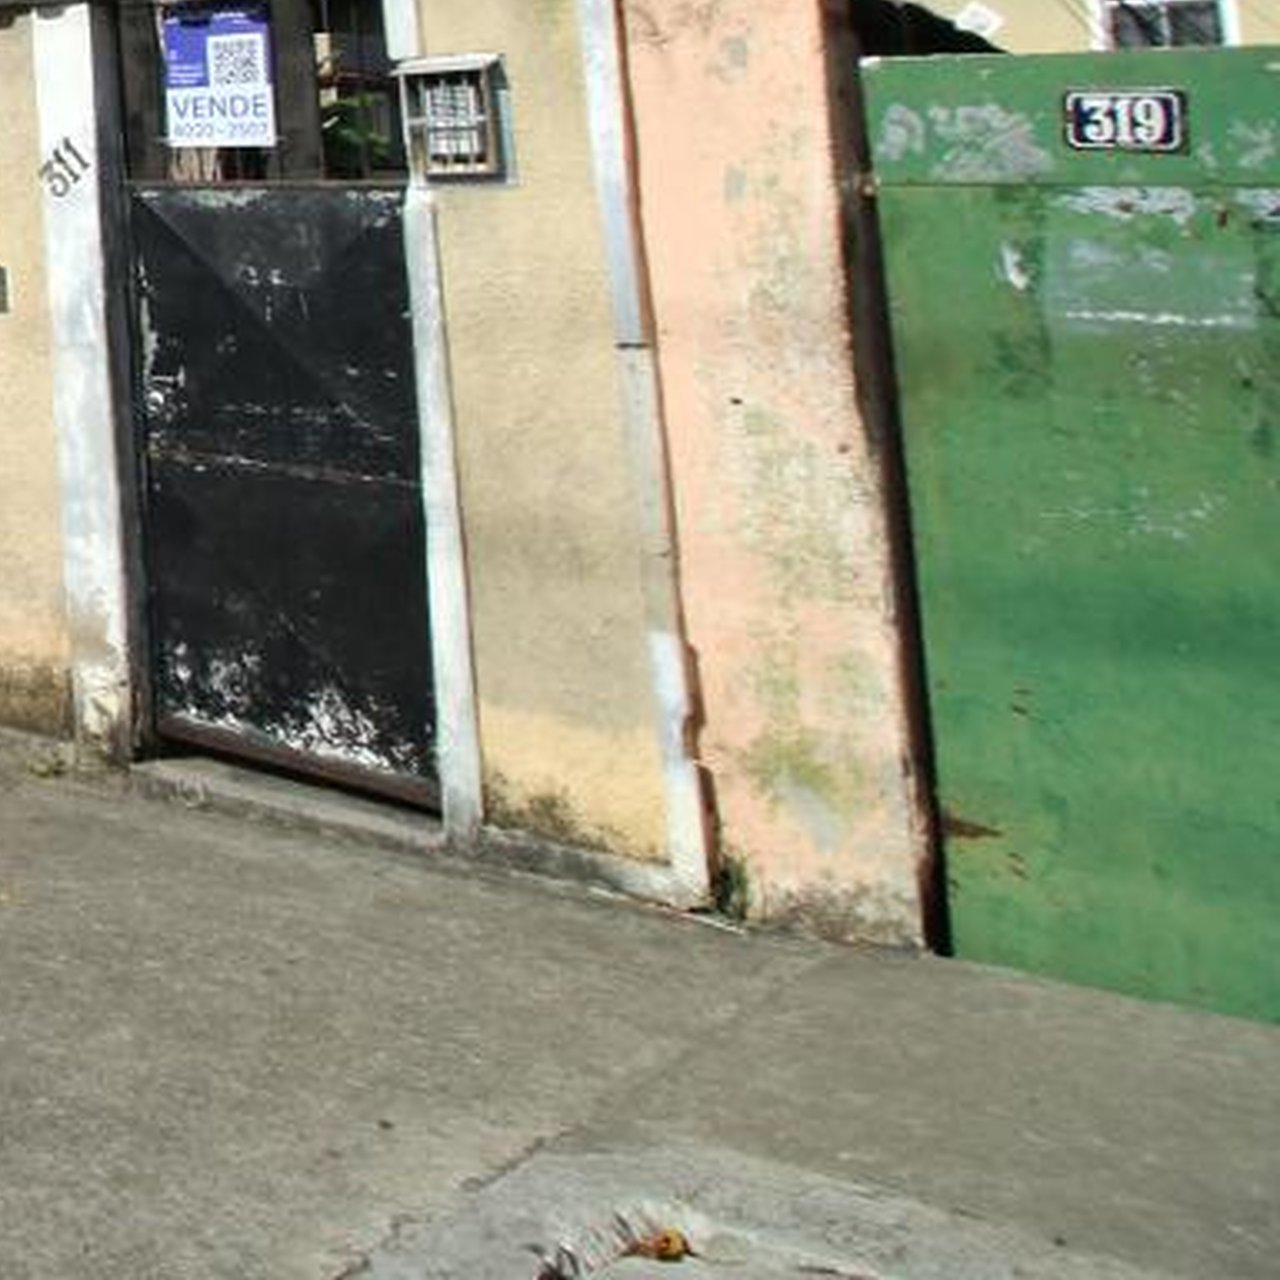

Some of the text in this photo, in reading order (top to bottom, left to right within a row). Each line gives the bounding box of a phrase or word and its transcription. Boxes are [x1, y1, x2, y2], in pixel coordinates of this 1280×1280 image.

[171, 93, 267, 118] VENDE
[1082, 97, 1166, 144] 319
[37, 136, 91, 198] 311
